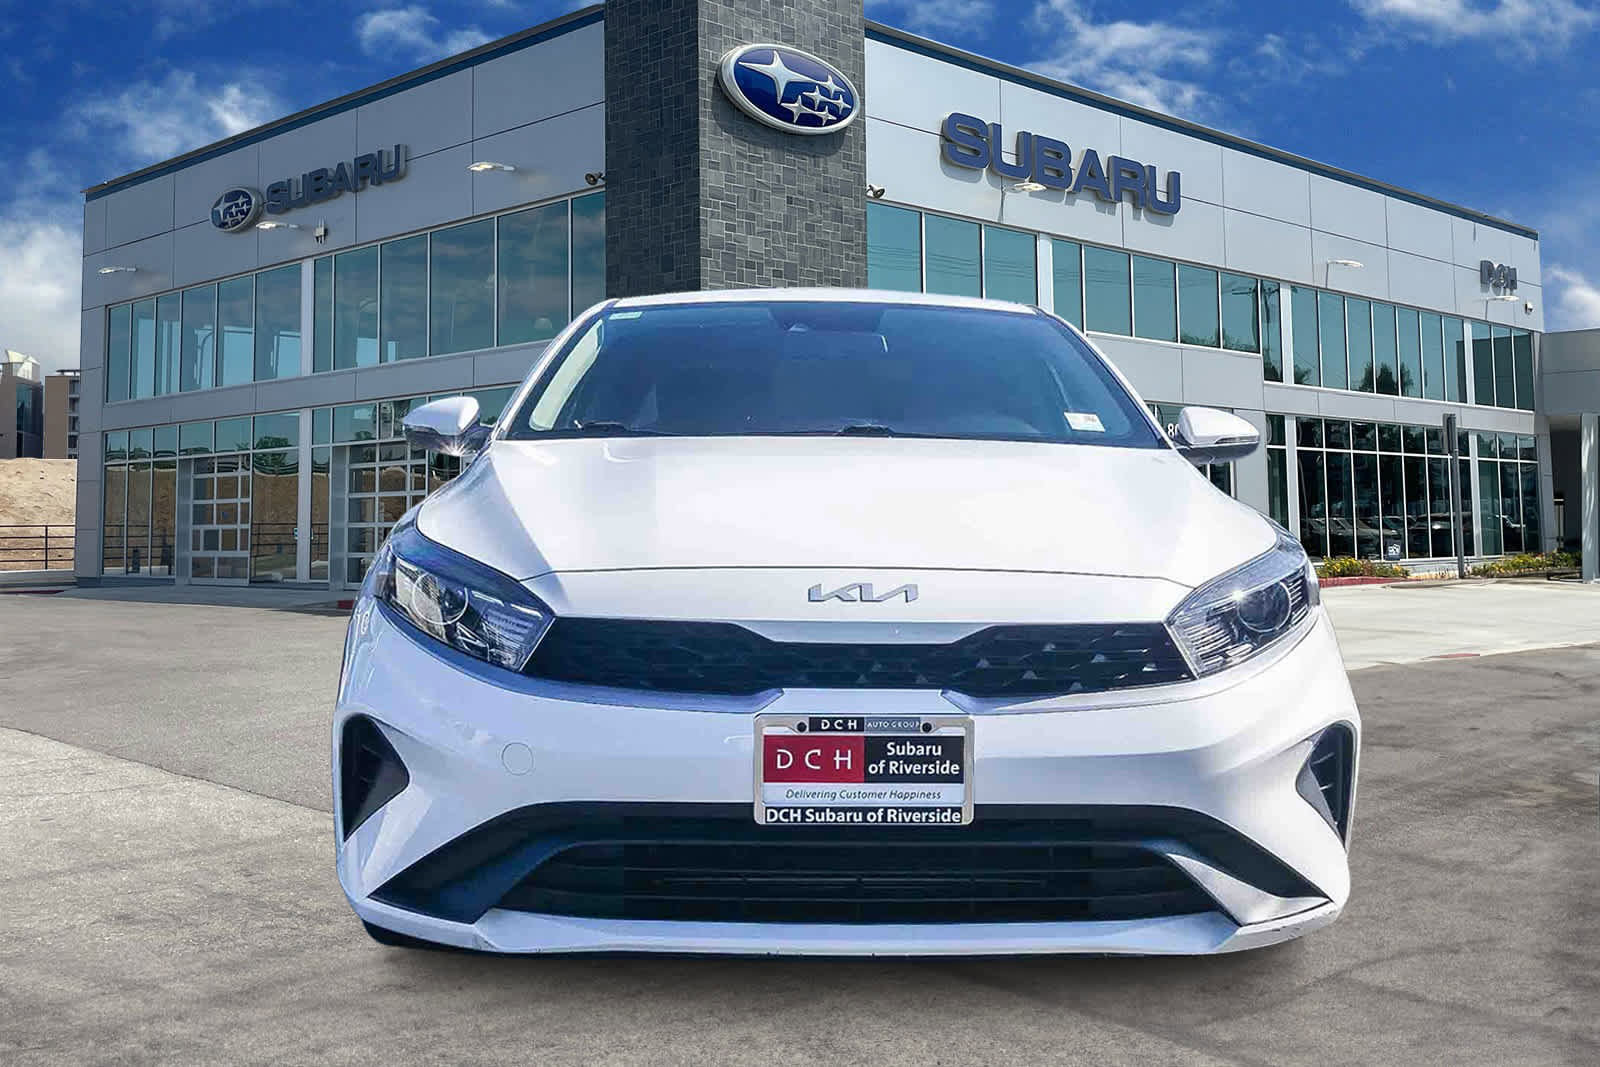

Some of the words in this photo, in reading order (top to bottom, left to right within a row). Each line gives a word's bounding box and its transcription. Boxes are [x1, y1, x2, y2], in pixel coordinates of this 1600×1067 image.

[942, 112, 1181, 215] SUBARU
[266, 144, 407, 215] SUBARU
[1480, 260, 1517, 290] DCH
[808, 583, 918, 602] KIA
[867, 720, 889, 728] AUTO
[891, 720, 920, 728] GROUP
[886, 742, 942, 756] Subaru
[868, 760, 886, 775] of
[889, 760, 960, 775] Riverside
[785, 789, 837, 801] Delivering
[839, 790, 887, 800] Customer
[889, 790, 941, 801] Happiness
[766, 809, 801, 823] DCH
[805, 808, 863, 823] Subaru
[866, 808, 885, 823] of
[887, 808, 961, 823] Riverside
